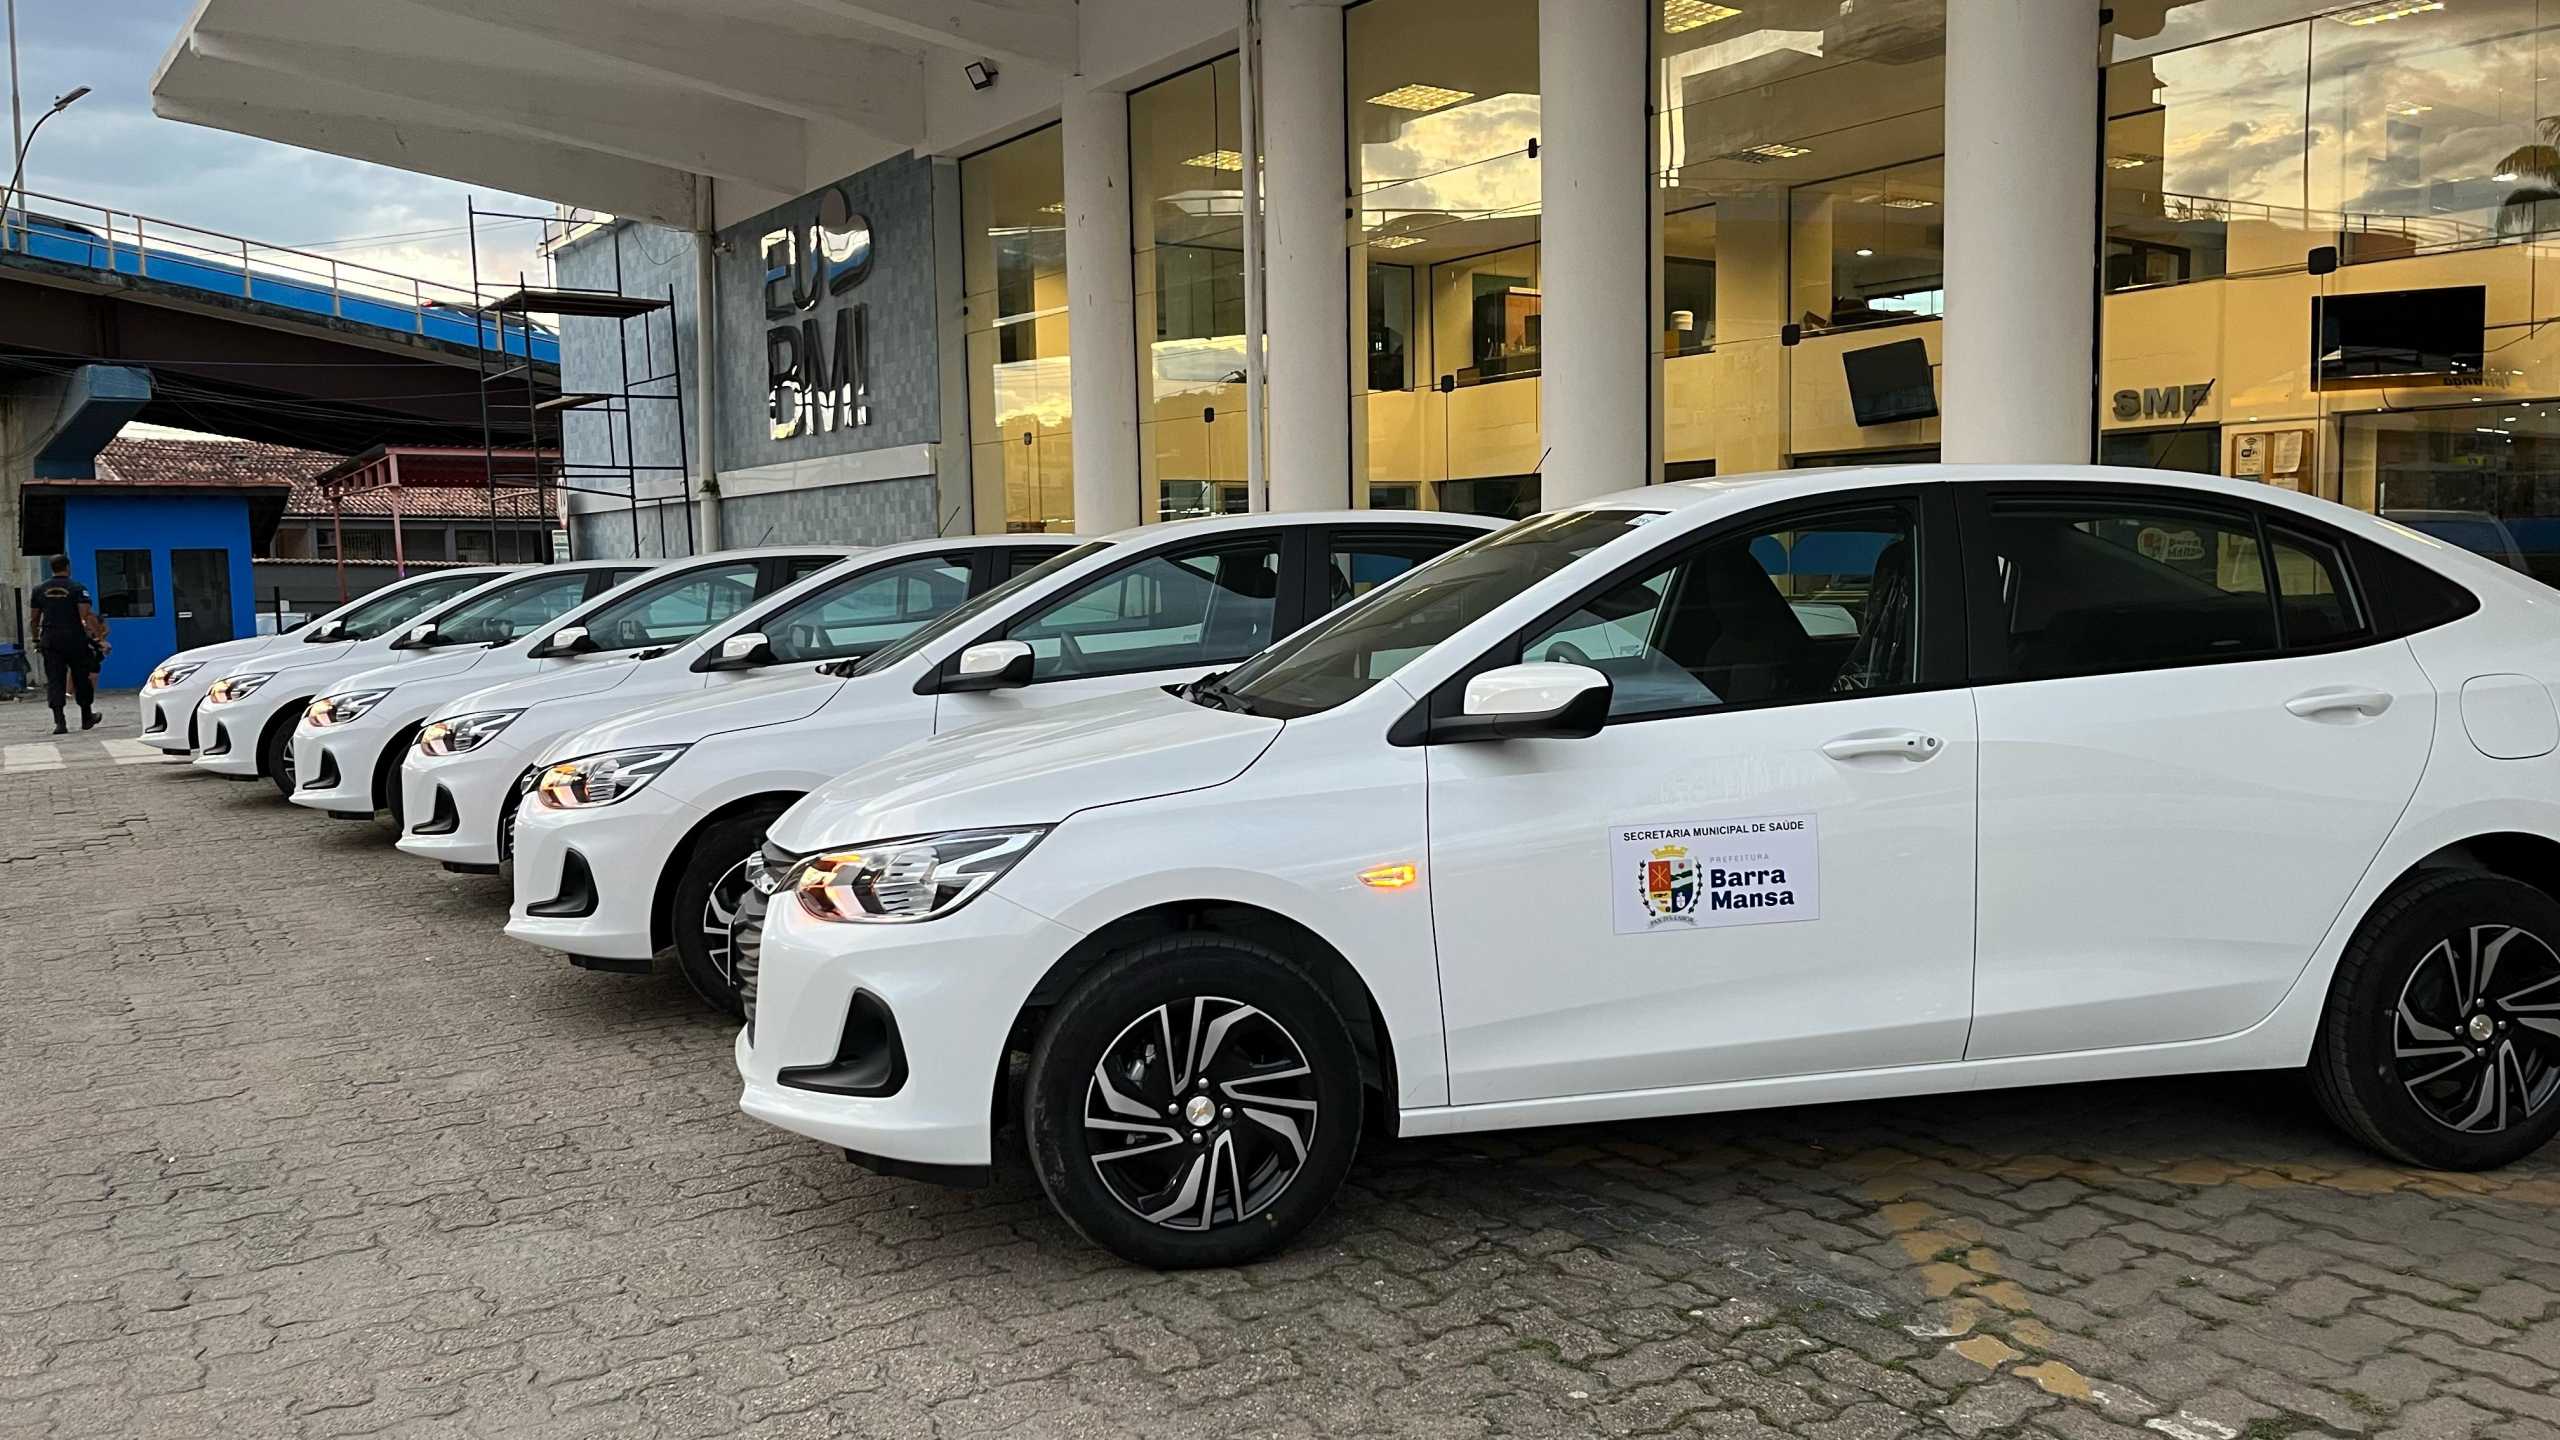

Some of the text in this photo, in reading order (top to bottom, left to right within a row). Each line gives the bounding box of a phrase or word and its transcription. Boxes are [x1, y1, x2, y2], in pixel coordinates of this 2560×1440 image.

[761, 225, 822, 321] EU
[767, 302, 870, 440] BM!
[2113, 383, 2210, 421] SMF
[1623, 820, 1805, 842] SECRETARIA MUNICIPAL DE SAÚDE
[1710, 853, 1769, 863] PREFEITURA
[1710, 869, 1786, 888] Barra
[1711, 890, 1794, 911] Mansa
